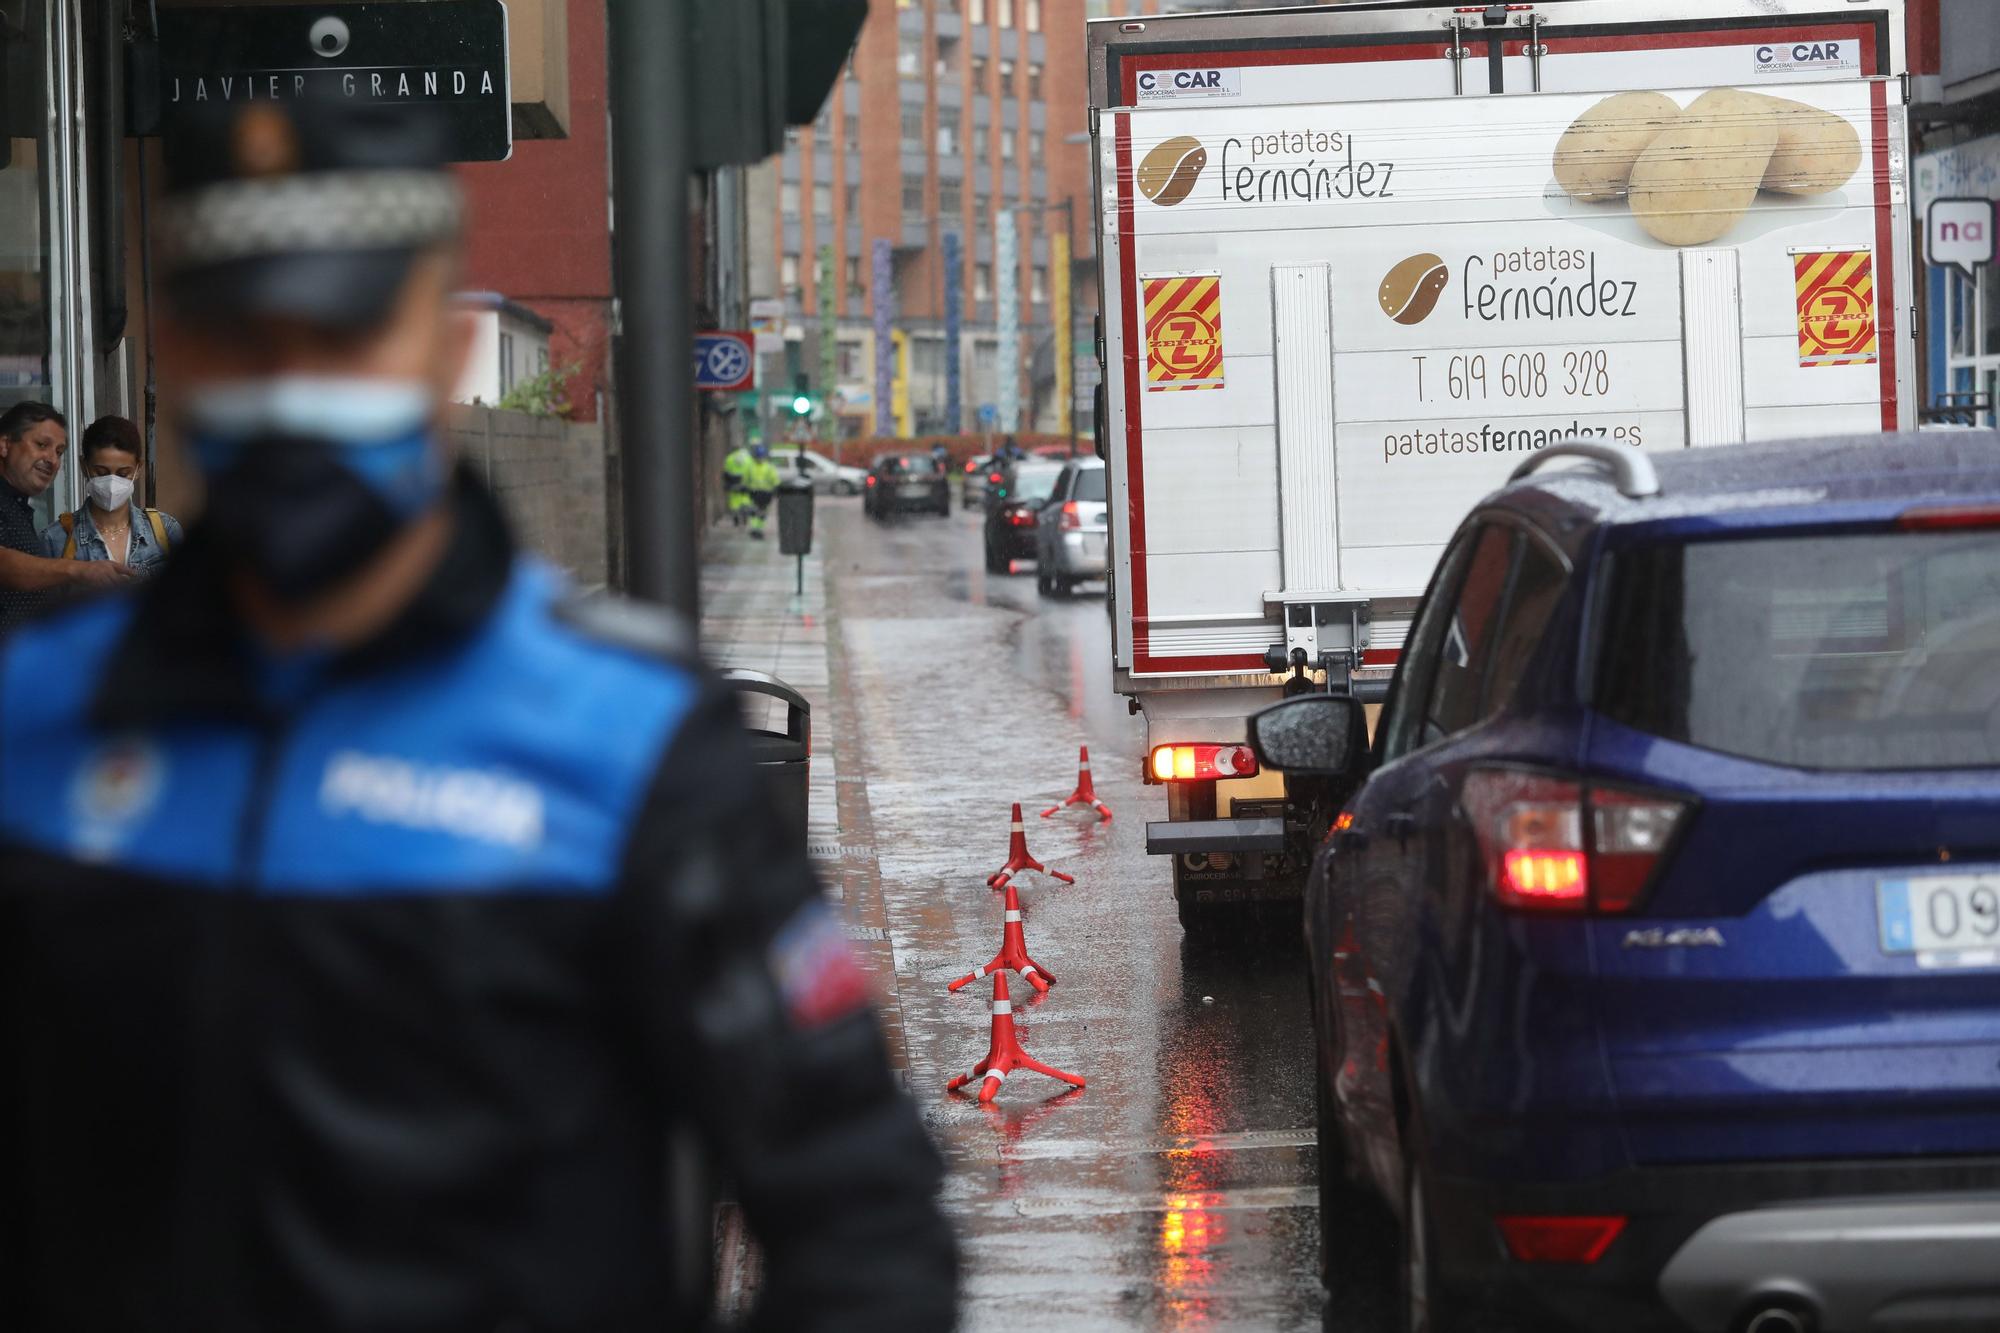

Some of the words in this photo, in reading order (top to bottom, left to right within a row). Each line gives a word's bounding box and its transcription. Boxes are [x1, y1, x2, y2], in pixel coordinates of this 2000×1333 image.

[172, 75, 304, 102] JAVIER
[343, 70, 494, 97] GRANDA
[1252, 129, 1343, 162] patatas
[1222, 134, 1394, 202] fernández
[1941, 221, 1983, 241] na
[1494, 245, 1585, 280] patatas
[1464, 251, 1637, 321] fernández
[1800, 312, 1870, 323] ZEPRO
[1150, 338, 1217, 348] ZEPRO
[1412, 356, 1434, 402] T.
[1448, 354, 1487, 400] 619
[1501, 351, 1547, 398] 608
[1563, 349, 1609, 396] 328
[1384, 420, 1642, 464] patatasfernandezes
